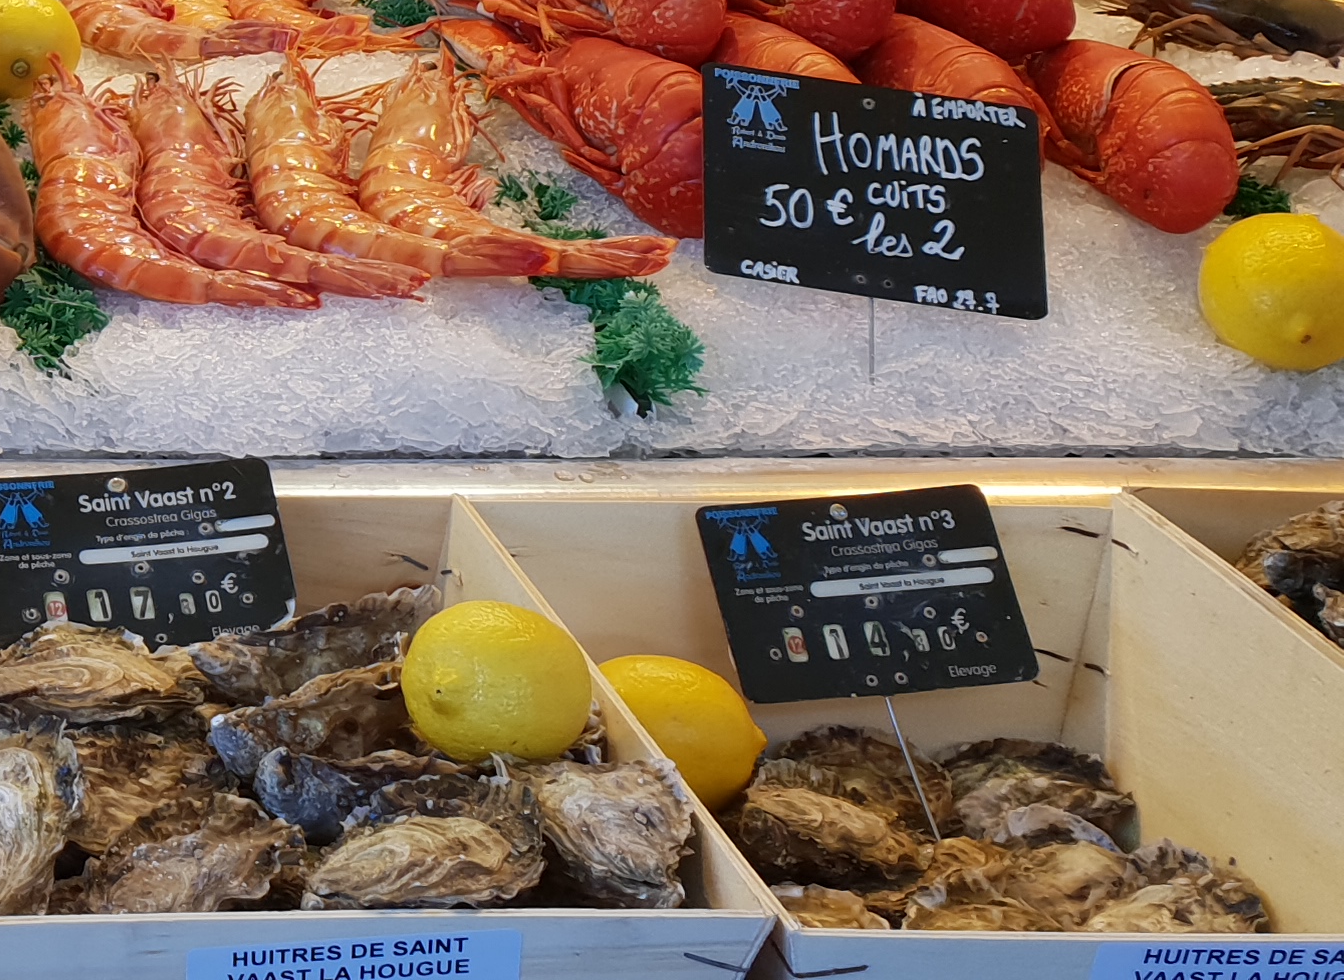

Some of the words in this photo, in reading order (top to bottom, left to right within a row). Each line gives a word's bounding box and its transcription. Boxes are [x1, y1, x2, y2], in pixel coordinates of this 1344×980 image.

[933, 98, 1026, 128] EMPORTER
[813, 112, 985, 182] HOMARDS
[868, 181, 946, 213] CUITS
[852, 213, 913, 258] les
[923, 220, 964, 260] 2
[741, 260, 799, 283] CASIER
[915, 286, 947, 303] FAO
[78, 494, 131, 513] Saint
[135, 489, 194, 509] Vaast
[198, 481, 236, 502] n°2
[106, 511, 178, 527] Crassostrea
[181, 508, 217, 523] Gigas
[801, 520, 853, 542] Saint
[858, 515, 914, 536] Vaast
[918, 509, 955, 531] n°3
[831, 541, 900, 557] Crassostrea
[903, 538, 939, 552] Gigas
[948, 664, 997, 678] Elevage
